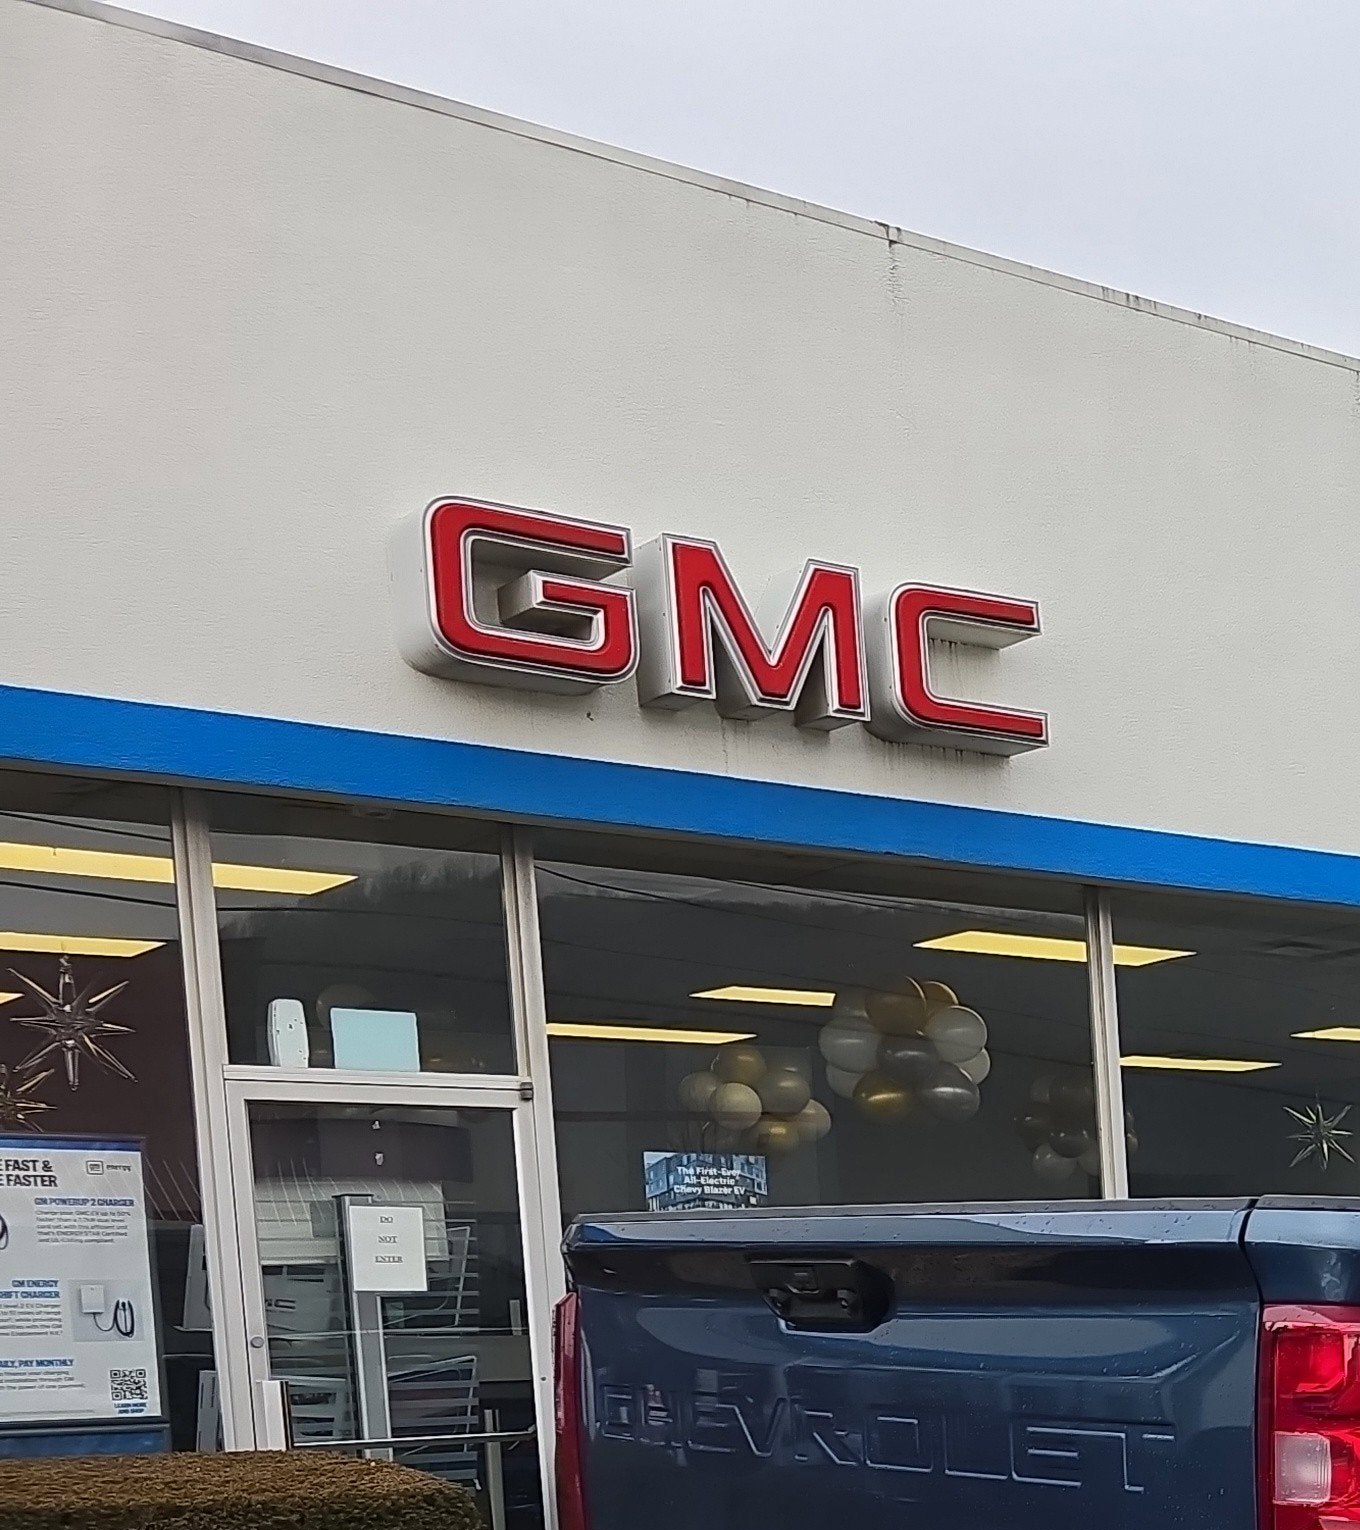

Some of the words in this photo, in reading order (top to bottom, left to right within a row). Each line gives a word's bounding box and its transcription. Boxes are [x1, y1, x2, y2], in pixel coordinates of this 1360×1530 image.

[422, 496, 1048, 748] GMC
[5, 1159, 39, 1172] FAST
[42, 1160, 53, 1172] &
[676, 1167, 695, 1175] The
[6, 1174, 58, 1187] FASTER
[684, 1176, 736, 1185] All-Electric
[674, 1185, 702, 1195] Chevy
[704, 1186, 732, 1195] Blazer
[734, 1186, 746, 1195] EV
[90, 1198, 96, 1206] 2
[97, 1198, 135, 1207] CHARGER
[375, 1255, 403, 1263] ENTER
[20, 1290, 61, 1299] CHARGER
[18, 1359, 35, 1367] PAY
[602, 1384, 1175, 1493] CHEVROLET
